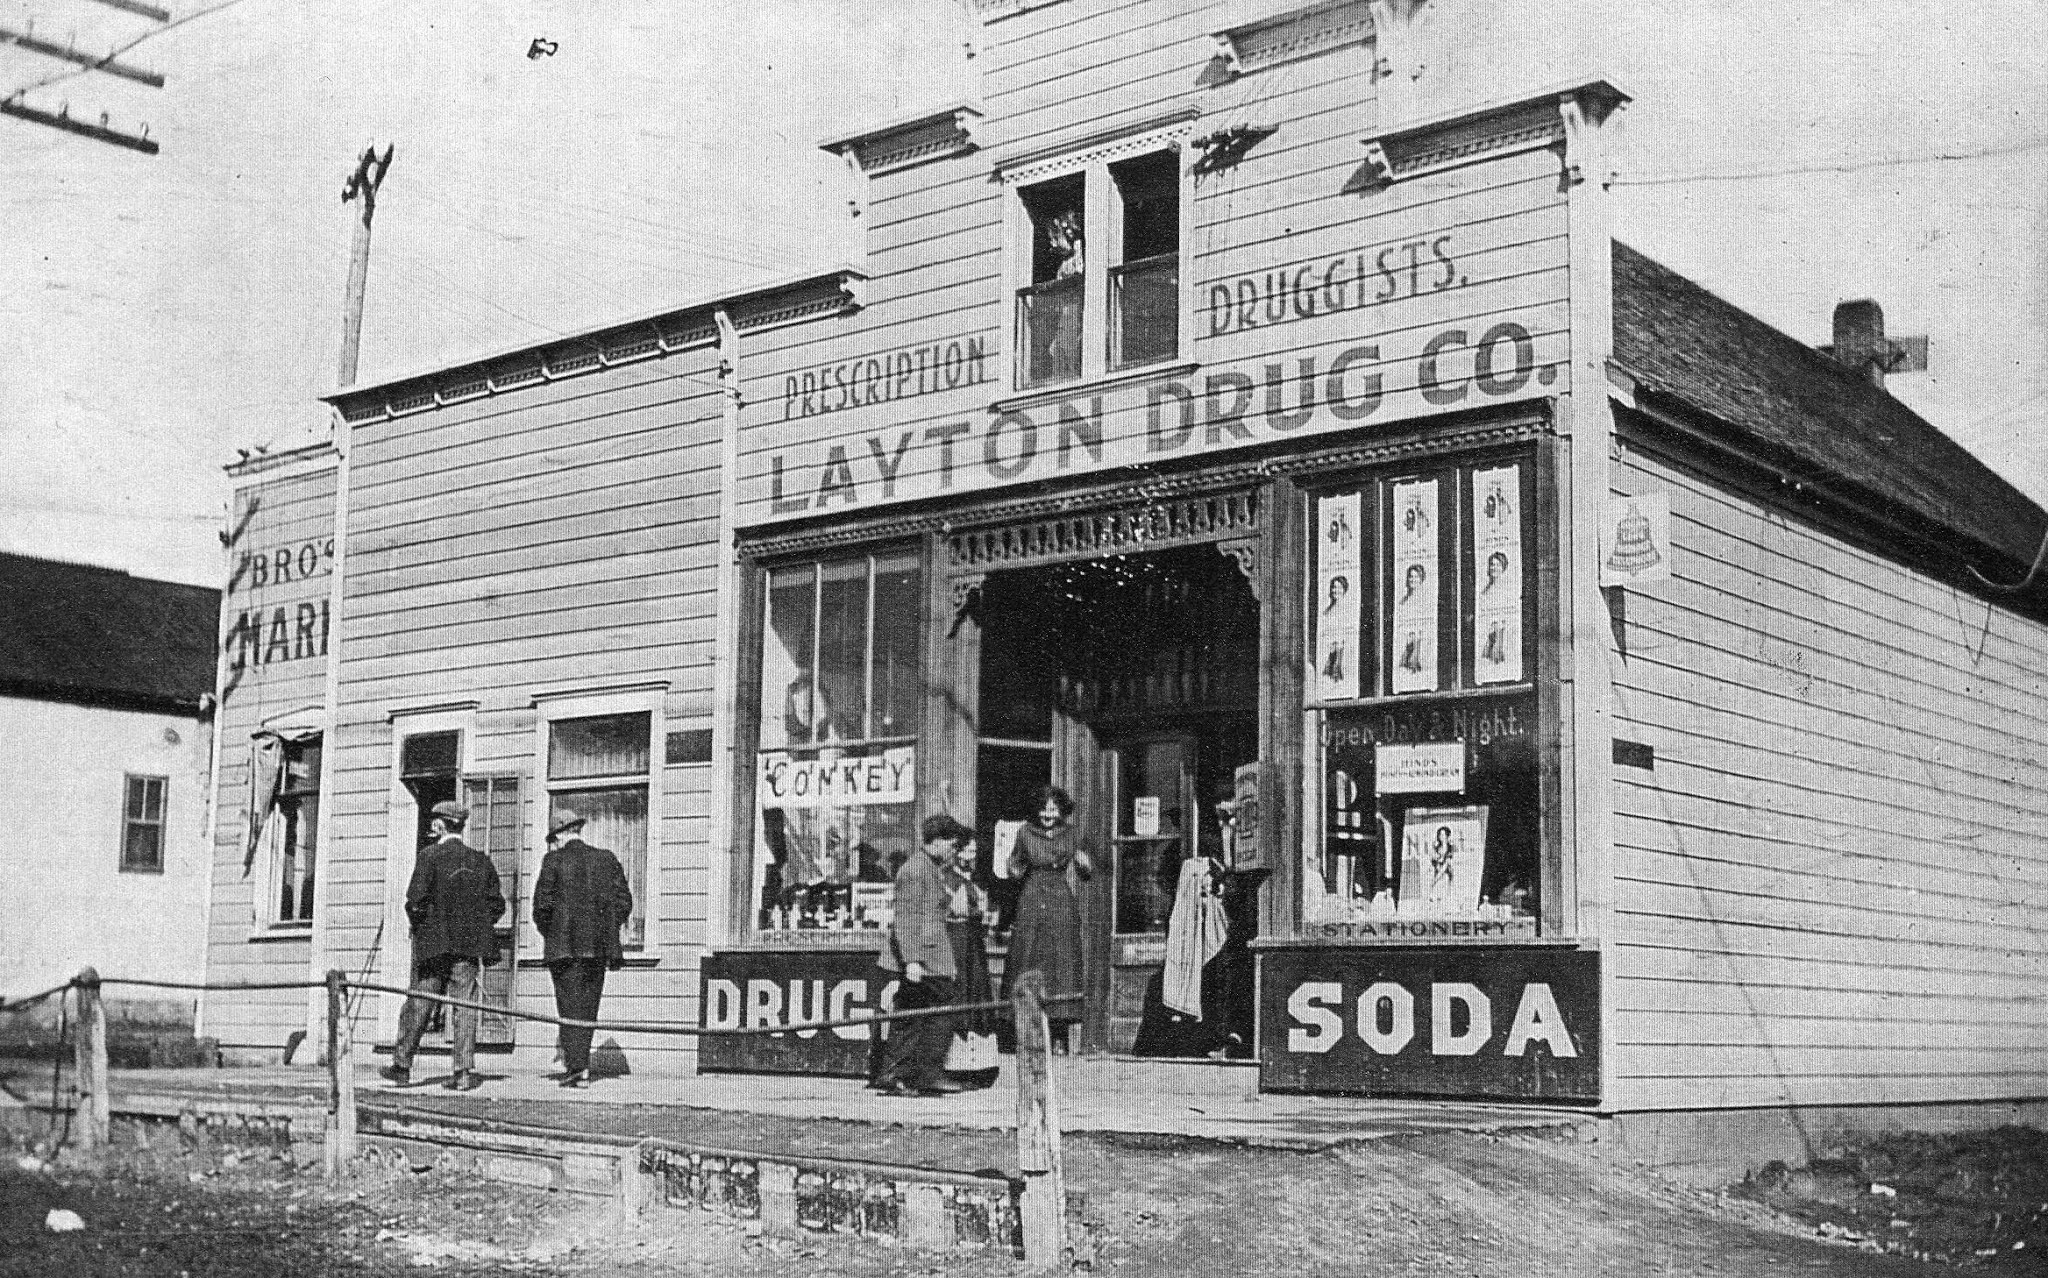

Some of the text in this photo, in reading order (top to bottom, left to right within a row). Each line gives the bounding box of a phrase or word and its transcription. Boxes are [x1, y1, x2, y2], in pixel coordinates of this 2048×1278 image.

[1210, 236, 1468, 336] DRUGGISTS.
[771, 322, 1559, 515] LAYTON DRUG CO.
[785, 336, 985, 420] PRESCRIPTION
[1322, 921, 1510, 937] STATIONERY
[1288, 982, 1578, 1057] SODA
